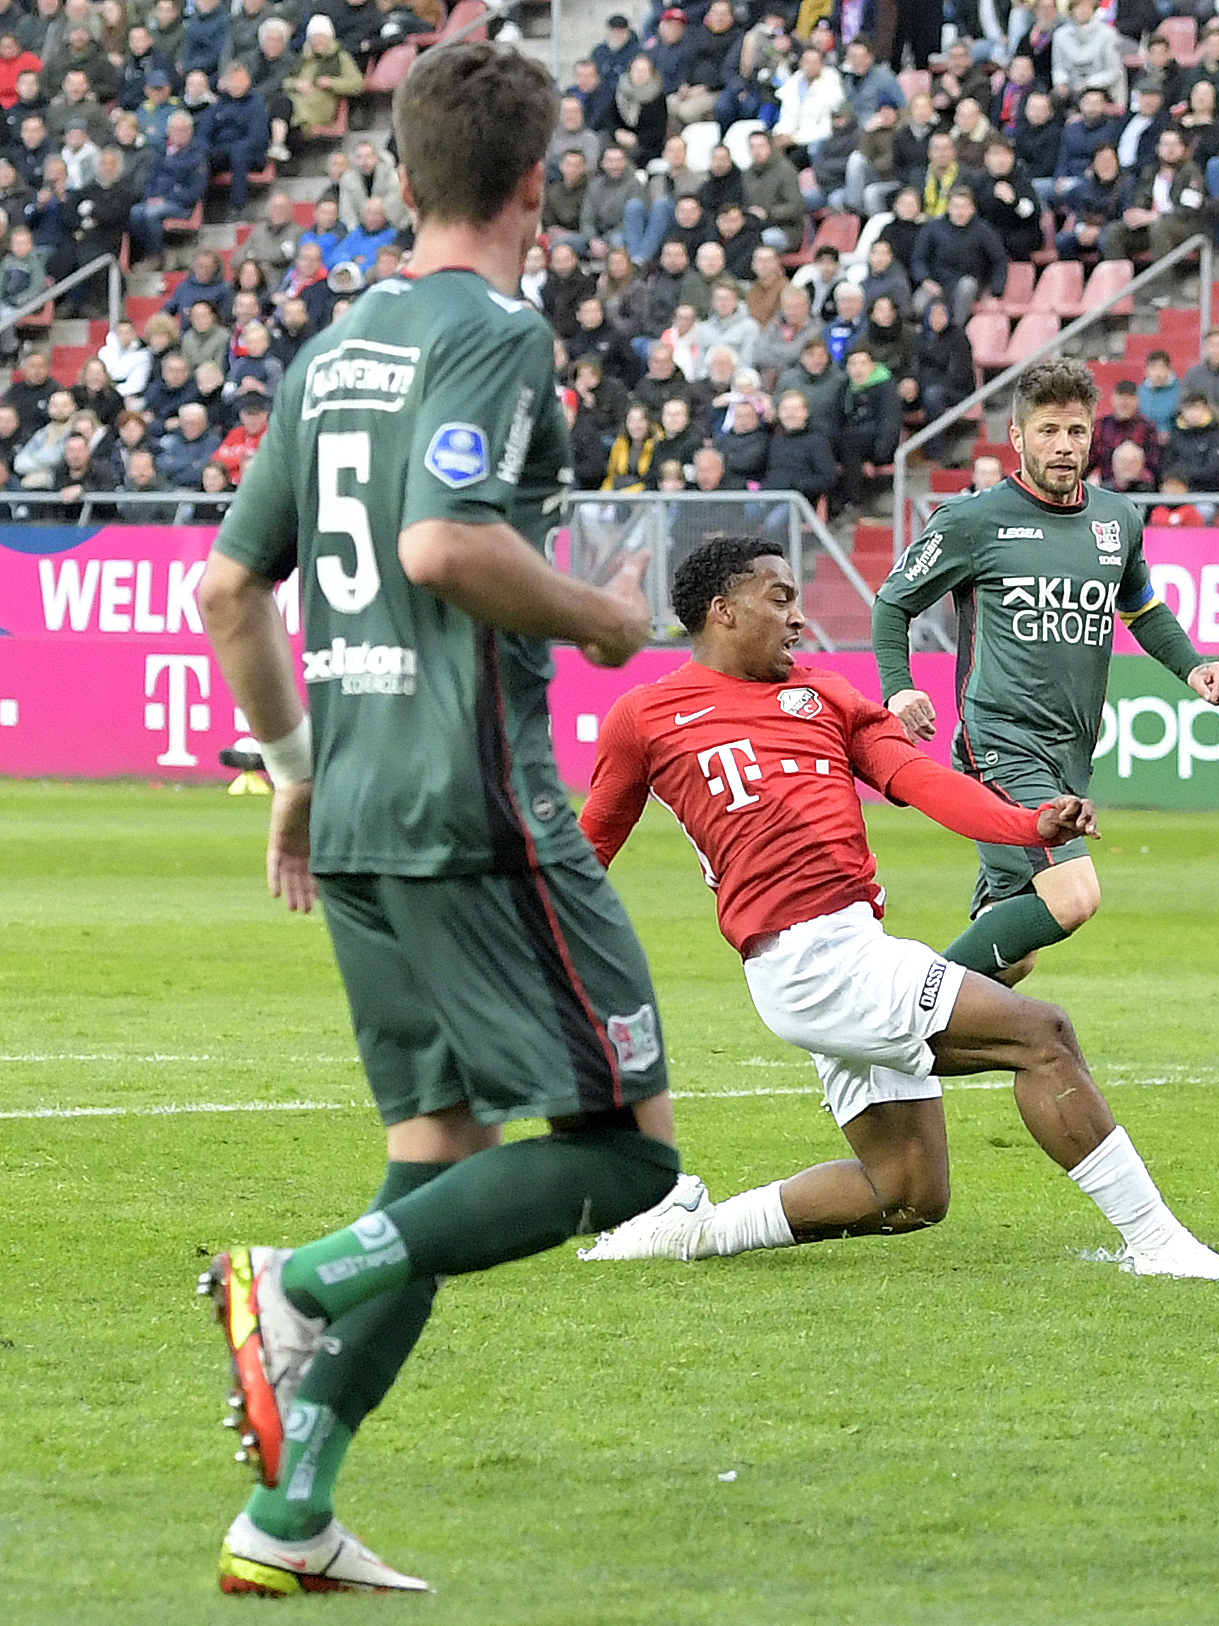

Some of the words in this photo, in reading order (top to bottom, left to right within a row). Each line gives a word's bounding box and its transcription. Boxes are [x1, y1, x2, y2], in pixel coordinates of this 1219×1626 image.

[317, 431, 380, 614] 5
[997, 527, 1045, 540] LEGEA
[904, 531, 944, 582] Hofmans
[1038, 577, 1121, 610] KLOK
[1012, 609, 1113, 647] GROEP
[920, 961, 947, 1008] DASSY
